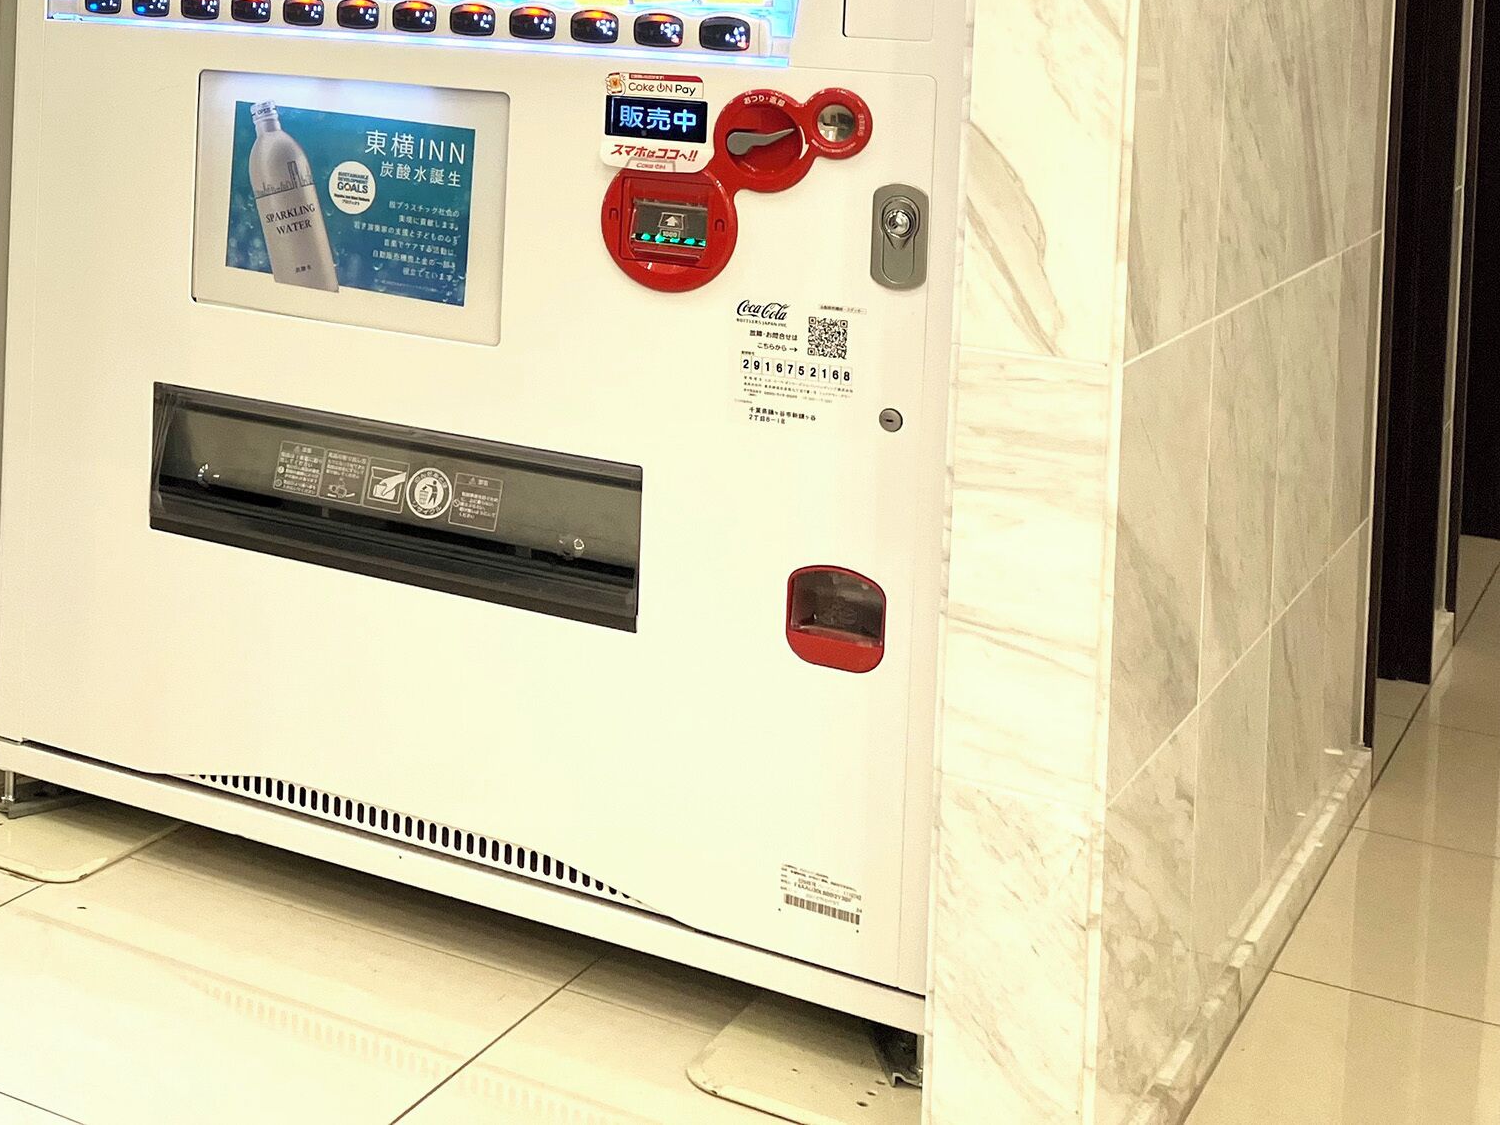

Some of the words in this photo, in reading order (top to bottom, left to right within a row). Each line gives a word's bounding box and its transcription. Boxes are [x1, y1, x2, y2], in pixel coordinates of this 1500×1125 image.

[628, 81, 654, 92] Coke
[656, 82, 673, 93] ON
[674, 83, 696, 97] Pay
[620, 105, 697, 133] 販売中
[365, 130, 465, 165] 東横INN
[610, 144, 698, 162] スマホはココへ!!
[379, 161, 462, 188] 炭酸水誕生
[337, 182, 368, 194] GOALS
[266, 203, 316, 224] SPARKLING
[276, 219, 312, 235] WATER
[736, 299, 790, 321] Coca-Cola
[757, 343, 787, 351] こちらから
[743, 359, 850, 382] 2916752168
